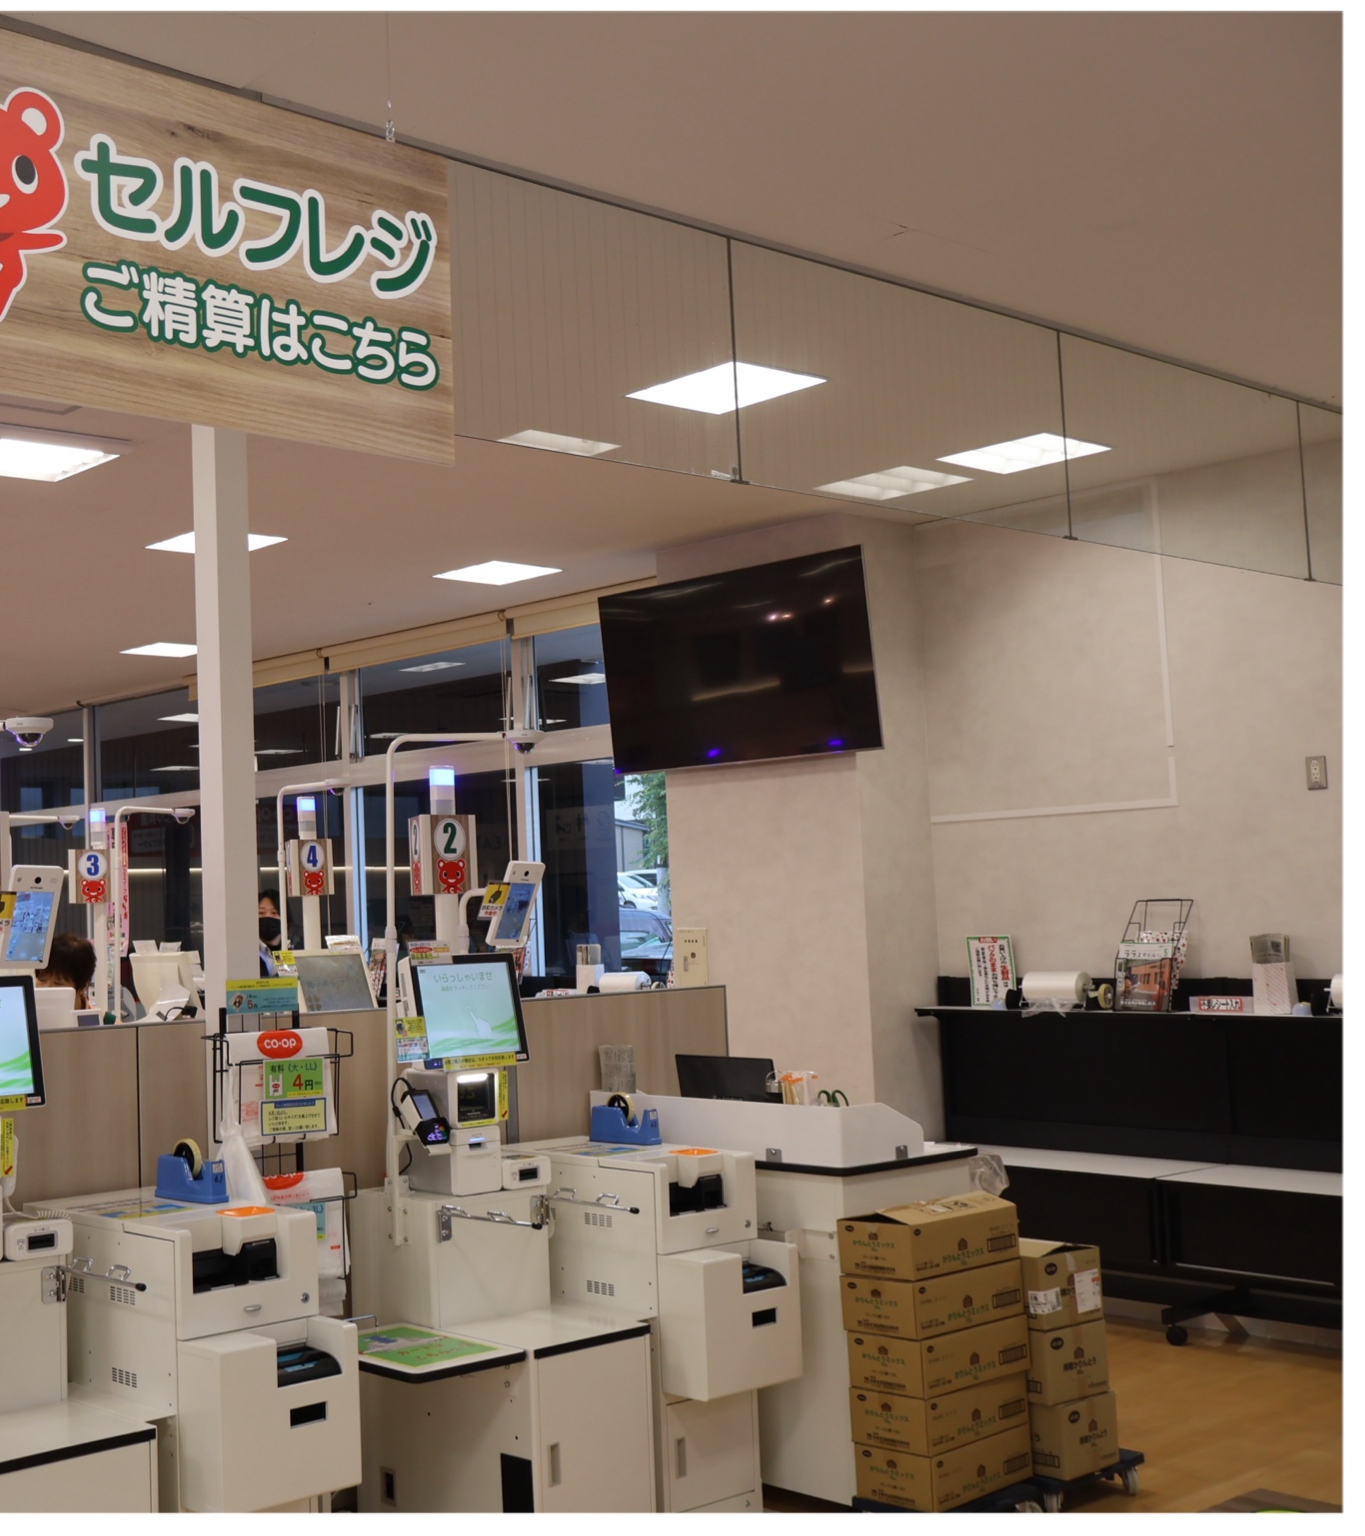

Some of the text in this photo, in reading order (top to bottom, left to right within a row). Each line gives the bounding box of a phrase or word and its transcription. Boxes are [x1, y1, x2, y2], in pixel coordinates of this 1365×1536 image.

[77, 137, 436, 297] セルフレジ
[82, 264, 439, 390] ご精算はこちら
[442, 822, 458, 854] 2
[86, 854, 100, 876] 3
[306, 843, 319, 868] 4
[433, 971, 494, 984] いらっしゃいませ
[292, 1073, 314, 1091] 4円
